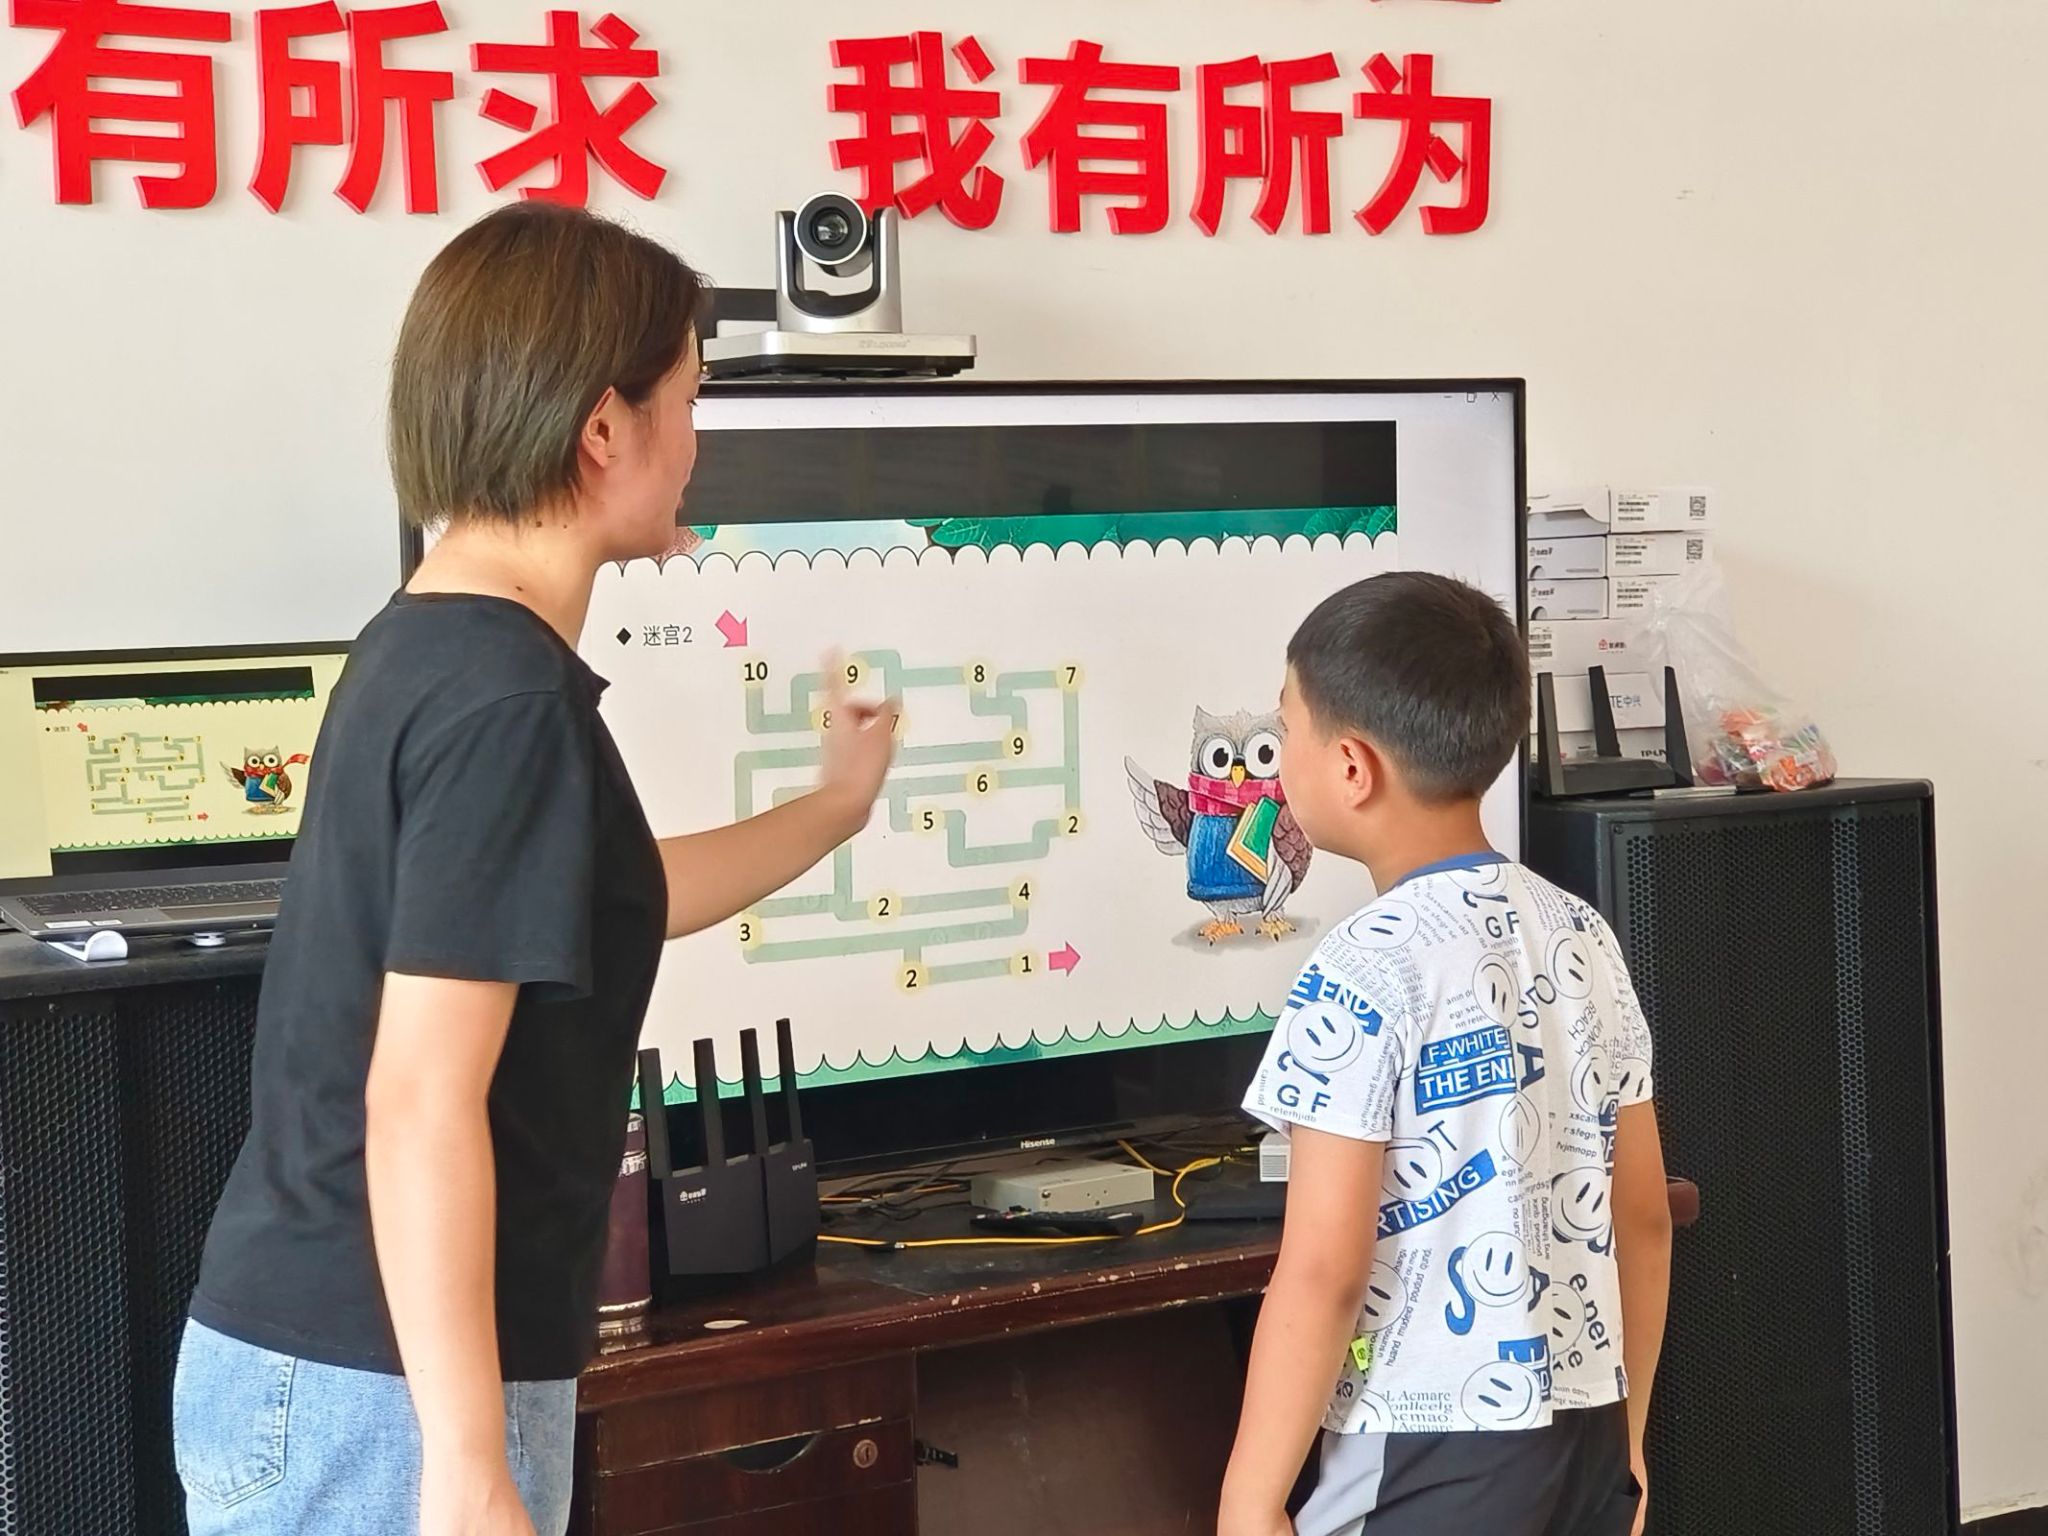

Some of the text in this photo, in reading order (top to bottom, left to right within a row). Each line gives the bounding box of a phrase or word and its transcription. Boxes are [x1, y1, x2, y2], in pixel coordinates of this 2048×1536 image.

[10, 0, 667, 214] 有所求
[827, 30, 1492, 237] 我有所为
[643, 624, 693, 647] 迷宫2
[743, 661, 768, 682] 10
[847, 665, 858, 684] 9
[974, 664, 985, 683] 8
[1066, 666, 1076, 684] 7
[1013, 737, 1024, 755] 9
[977, 774, 988, 793] 6
[923, 811, 934, 830] 5
[1068, 815, 1078, 834] 2
[1018, 882, 1030, 900] 4
[878, 897, 889, 916] 2
[740, 923, 751, 942] 3
[1022, 955, 1032, 973] 1
[906, 969, 917, 988] 2
[1420, 1068, 1472, 1099] THE
[1277, 1084, 1301, 1108] G
[1311, 1091, 1331, 1114] F
